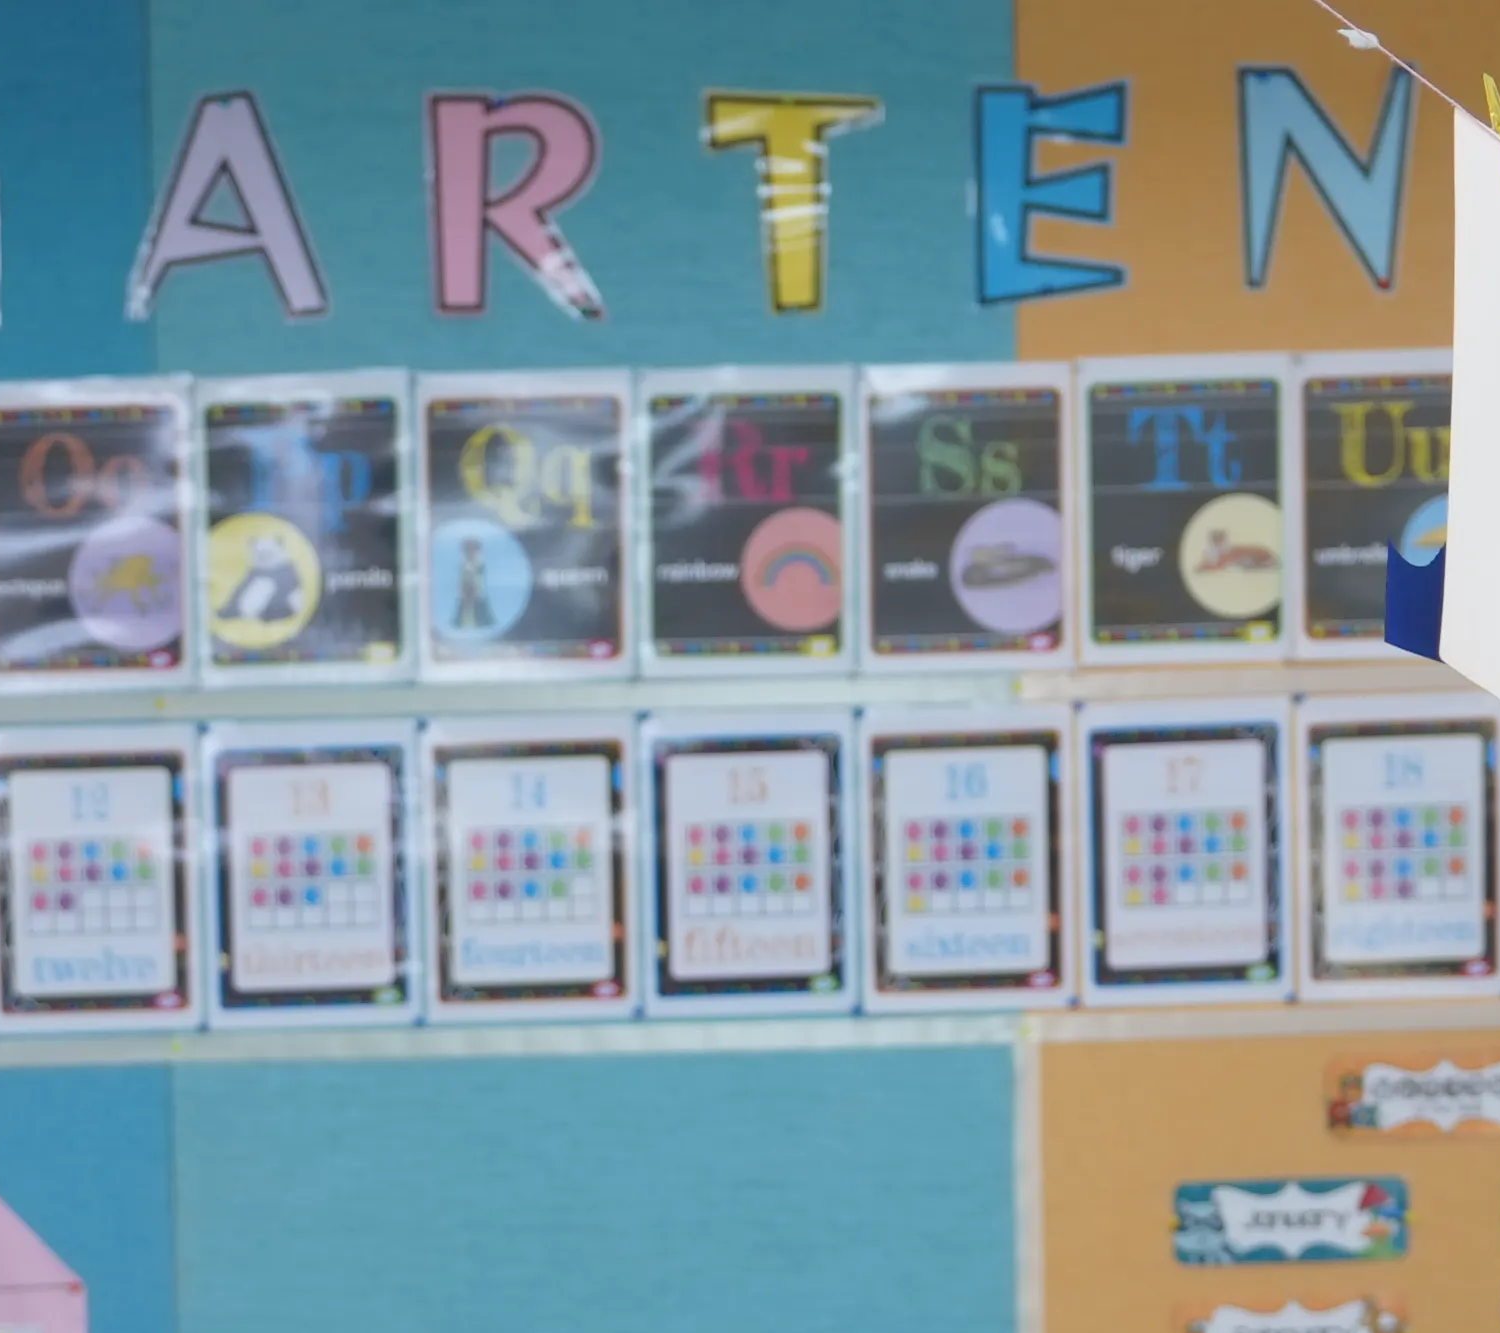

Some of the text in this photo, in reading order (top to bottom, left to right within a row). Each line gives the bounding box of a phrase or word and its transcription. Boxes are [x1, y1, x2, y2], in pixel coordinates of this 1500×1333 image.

[20, 433, 145, 519] Oo
[460, 424, 594, 528] Qq
[918, 415, 1022, 498] Ss
[1126, 405, 1241, 491] Tt
[32, 949, 157, 984] twelve
